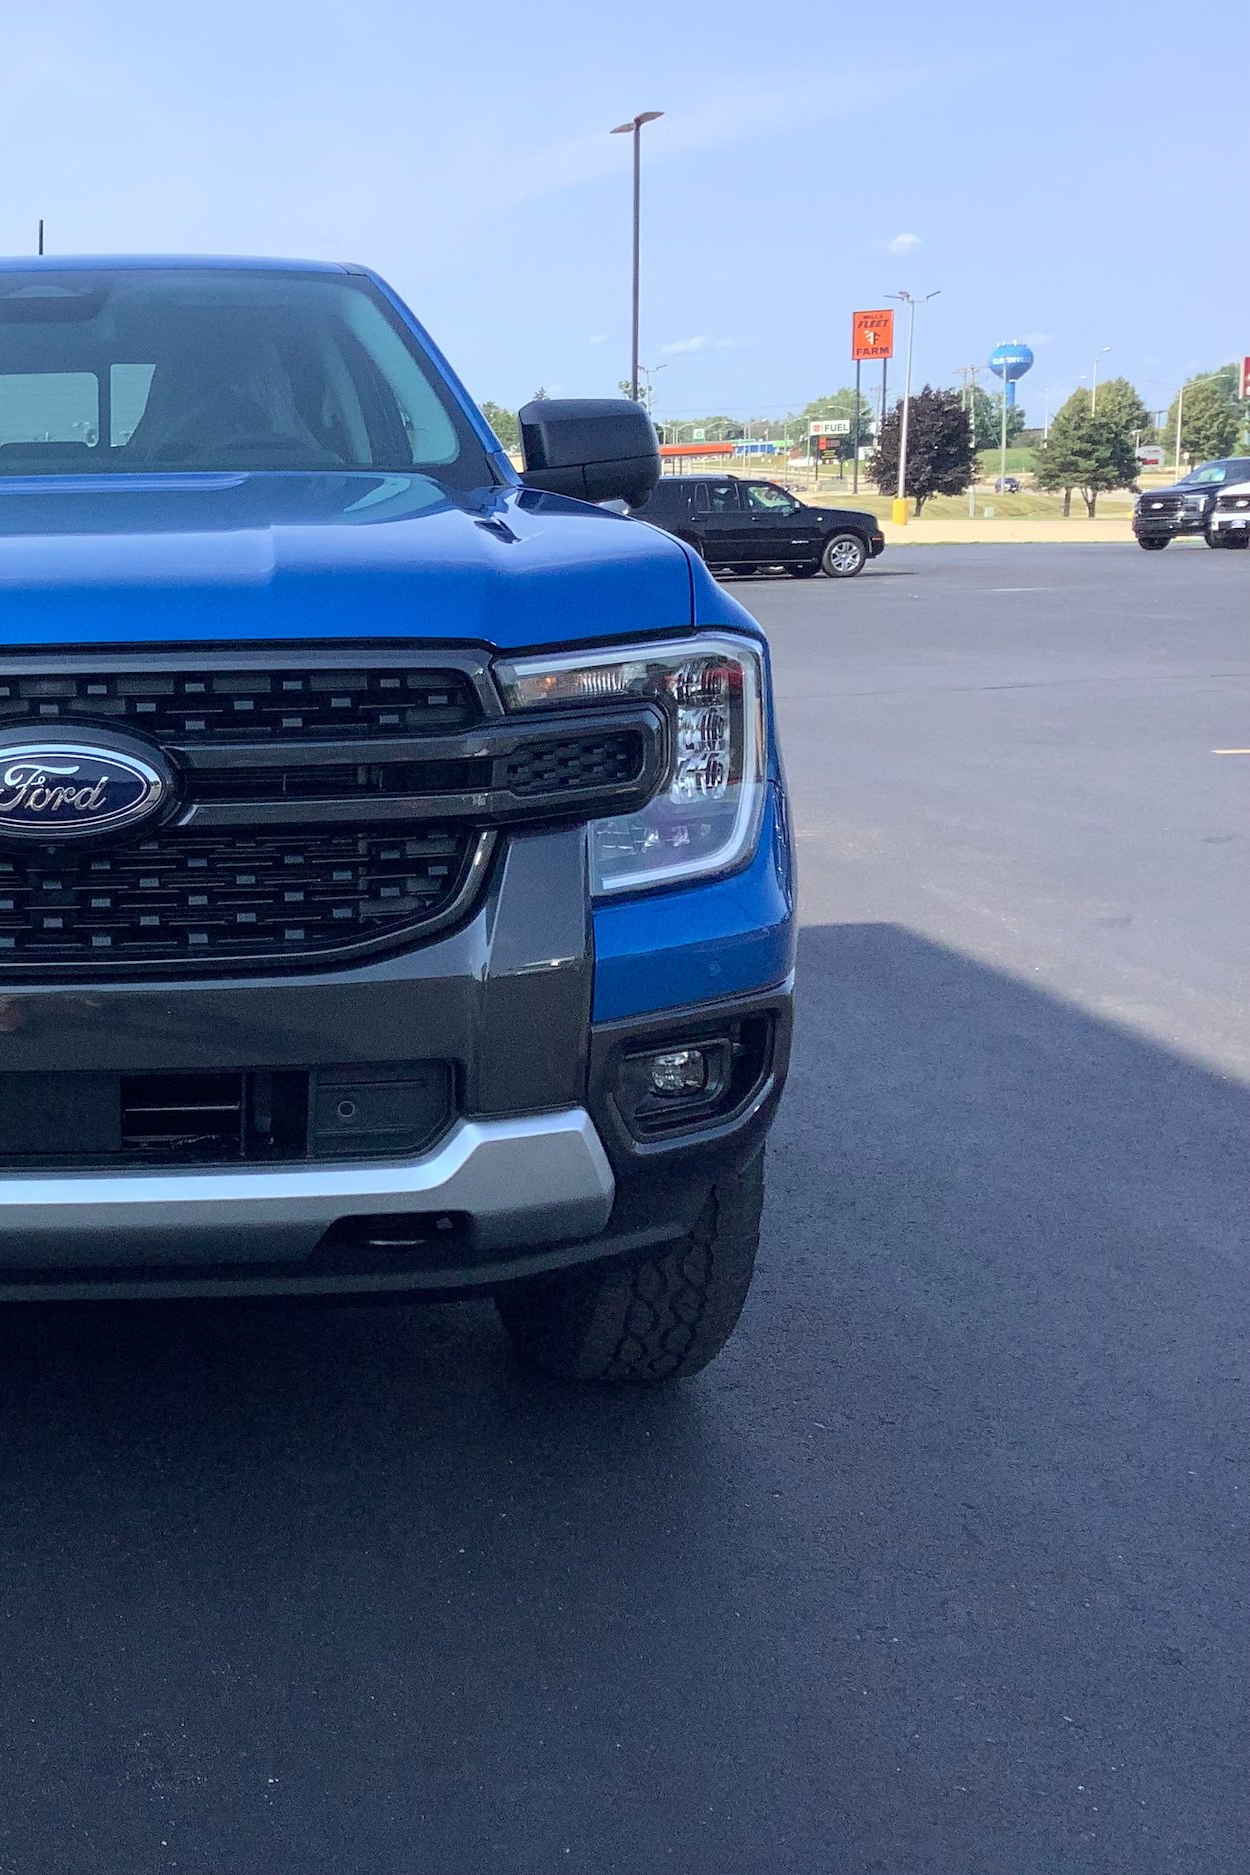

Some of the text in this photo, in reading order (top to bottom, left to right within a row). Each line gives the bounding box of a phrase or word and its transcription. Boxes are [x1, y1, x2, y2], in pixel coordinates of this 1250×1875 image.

[857, 319, 889, 328] FLEET
[856, 346, 890, 356] FARM
[824, 423, 849, 432] FUEL
